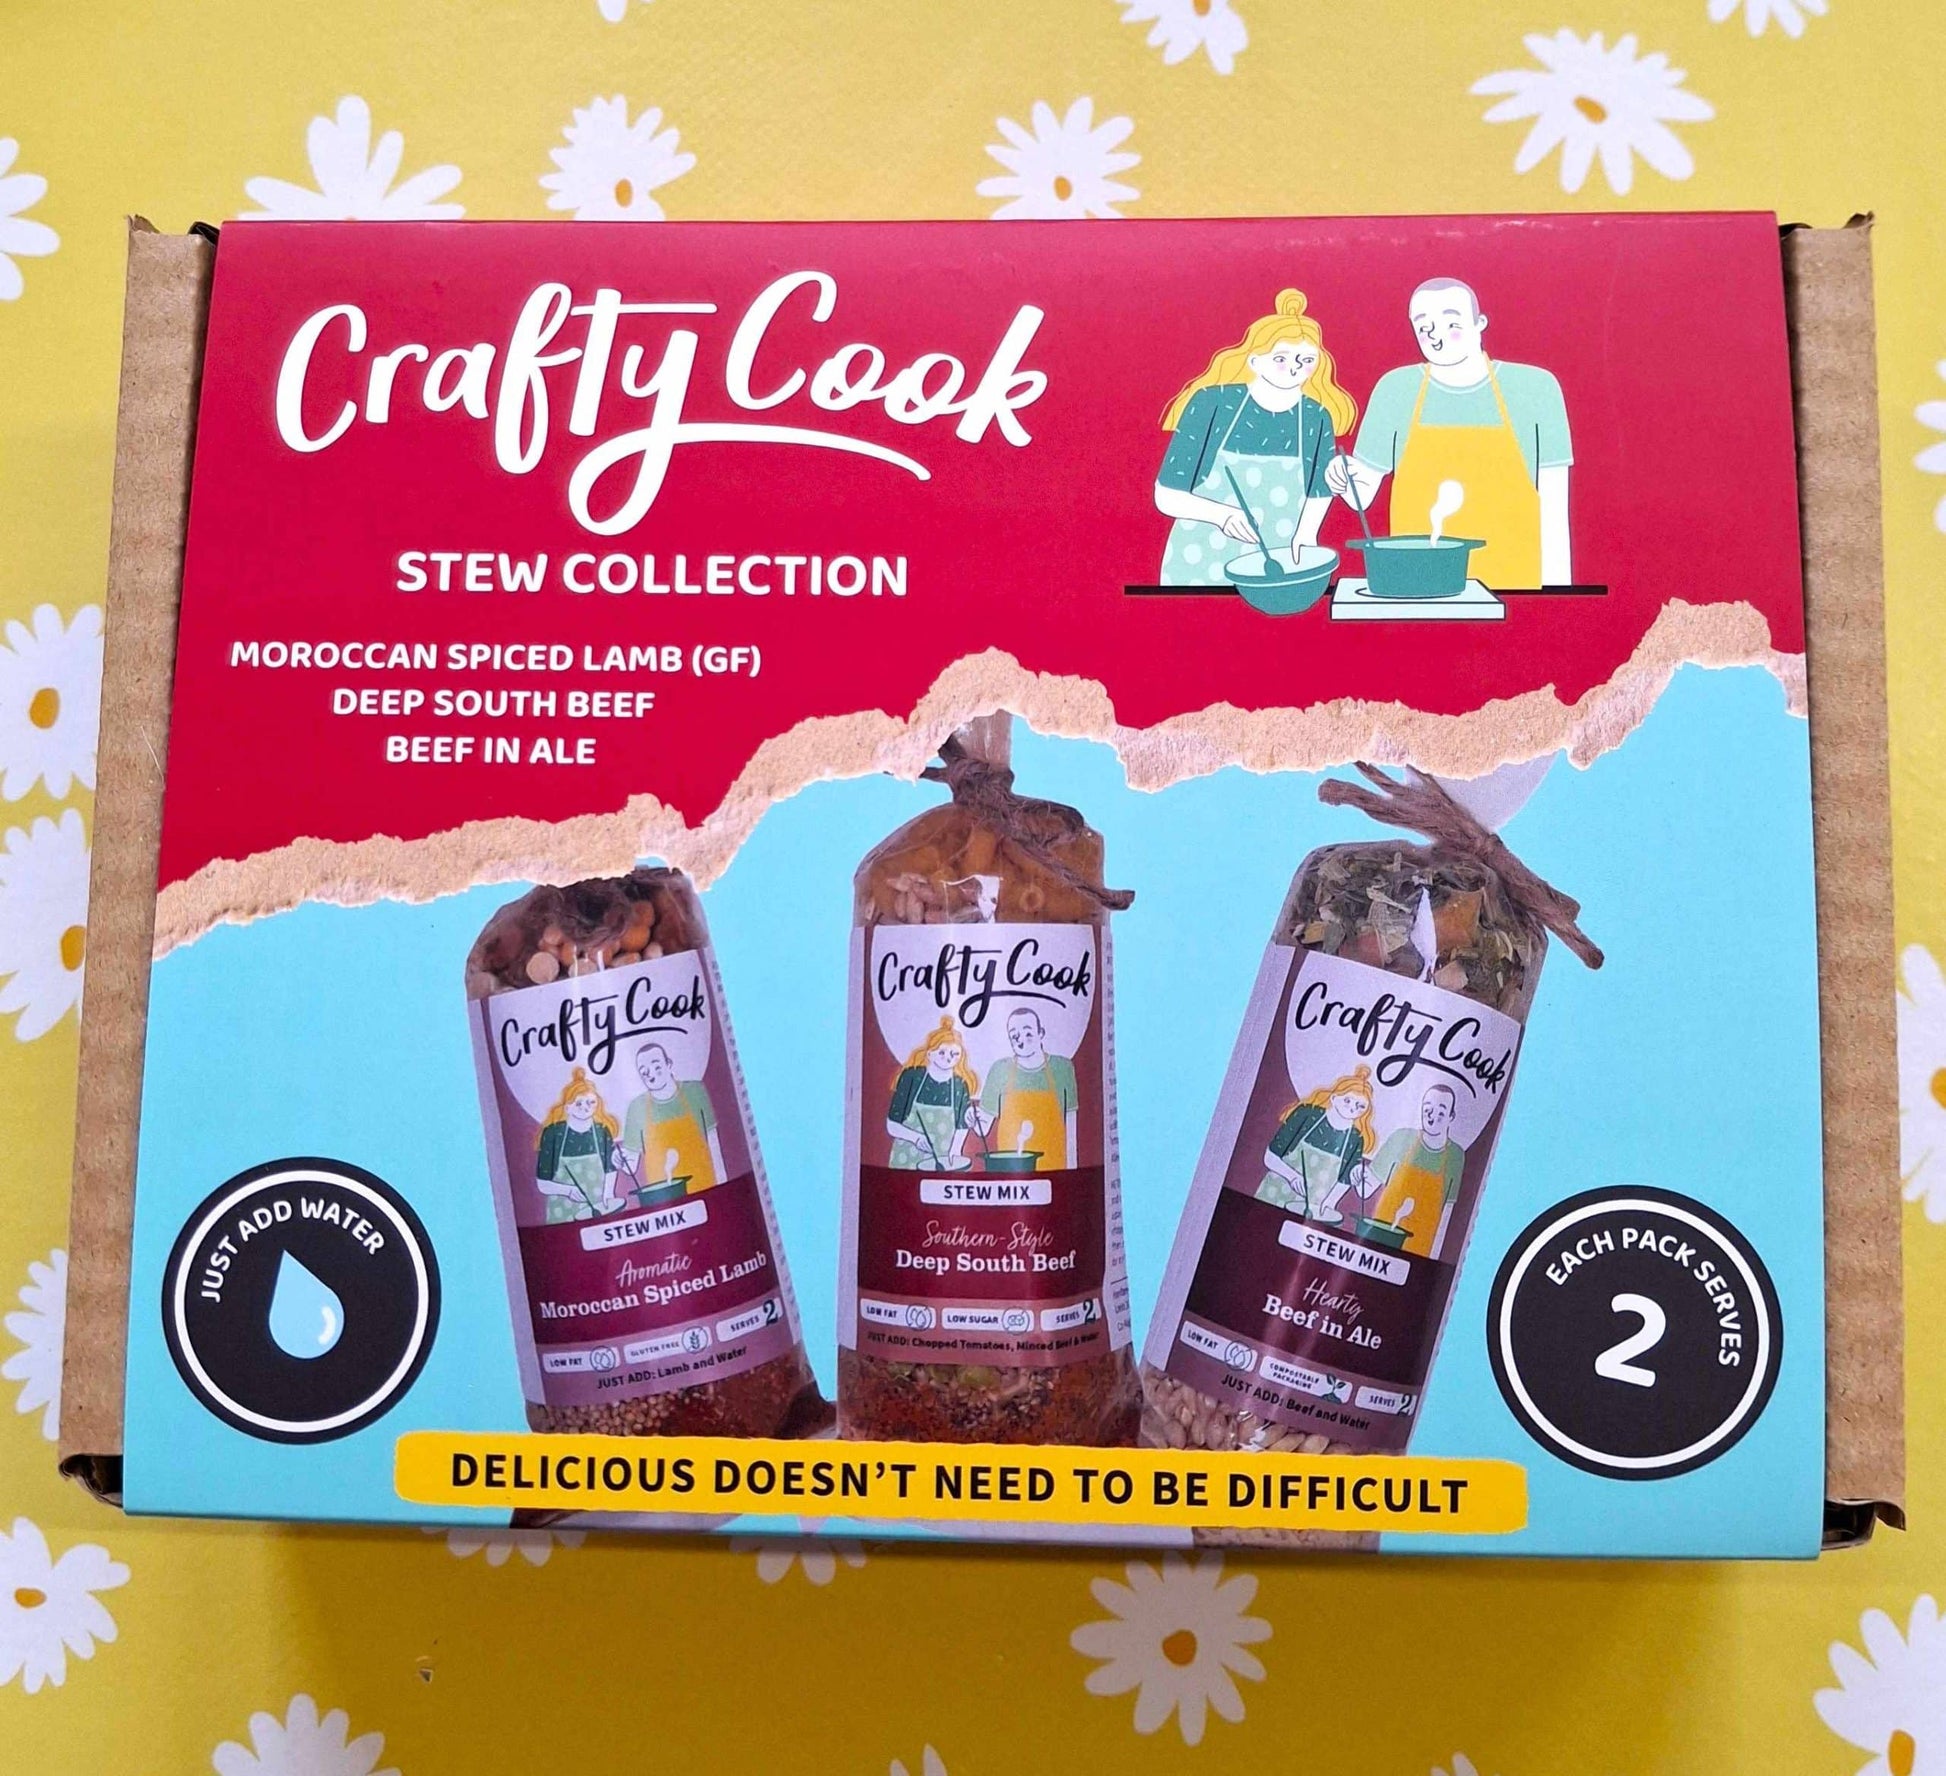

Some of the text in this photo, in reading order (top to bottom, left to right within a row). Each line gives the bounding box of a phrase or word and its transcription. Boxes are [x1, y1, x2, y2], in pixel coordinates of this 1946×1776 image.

[274, 270, 1048, 537] Crafty Cook
[396, 551, 909, 598] STEW COLLECTION
[230, 641, 763, 678] MOROCCAN SPICED LAMB (GF)
[332, 688, 656, 719] DEEP SOUTH BEEF
[385, 735, 597, 766] BEEF IN ALE
[878, 938, 1091, 1029] Crafty Cook
[501, 993, 688, 1075] Crafty
[625, 975, 707, 1026] Cook
[1294, 981, 1511, 1098] Crafty Cook
[943, 1184, 1031, 1201] STEW MIX
[602, 1209, 688, 1243] STEW MIX
[921, 1220, 1055, 1256] Southern-Style
[200, 1196, 386, 1303] JUST ADD WATER
[896, 1249, 1077, 1275] Deep South Beef
[1302, 1232, 1391, 1276] STEW MIX
[539, 1250, 767, 1320] Moroccan Spiced Lamb
[615, 1252, 693, 1289] Aromatic
[866, 1305, 898, 1319] LOW FAT
[1055, 1311, 1080, 1325] SERVES
[1082, 1298, 1097, 1325] 2
[1304, 1277, 1366, 1325] Hearty
[1545, 1227, 1743, 1367] EACH PACK SERVES
[730, 1315, 760, 1333] SERVES
[762, 1299, 779, 1326] 2
[947, 1315, 999, 1325] LOW SUGAR
[1261, 1293, 1383, 1350] Beef in Ale
[630, 1345, 660, 1357] GLUTEN
[911, 1336, 958, 1350] Chopped
[959, 1339, 1015, 1352] Tomatoes,
[1016, 1337, 1054, 1351] Minced
[1187, 1329, 1219, 1350] LOW FAT
[1594, 1292, 1667, 1388] 2
[549, 1356, 583, 1368] LOW FAT
[596, 1345, 748, 1390] JUST ADD: Lamb and Water
[1220, 1373, 1372, 1431] JUST ADD: Beef and Water
[1369, 1392, 1416, 1416] SERVES 2
[452, 1452, 1469, 1514] DELICIOUS DOESN’T NEED TO BE DIFFICULT
